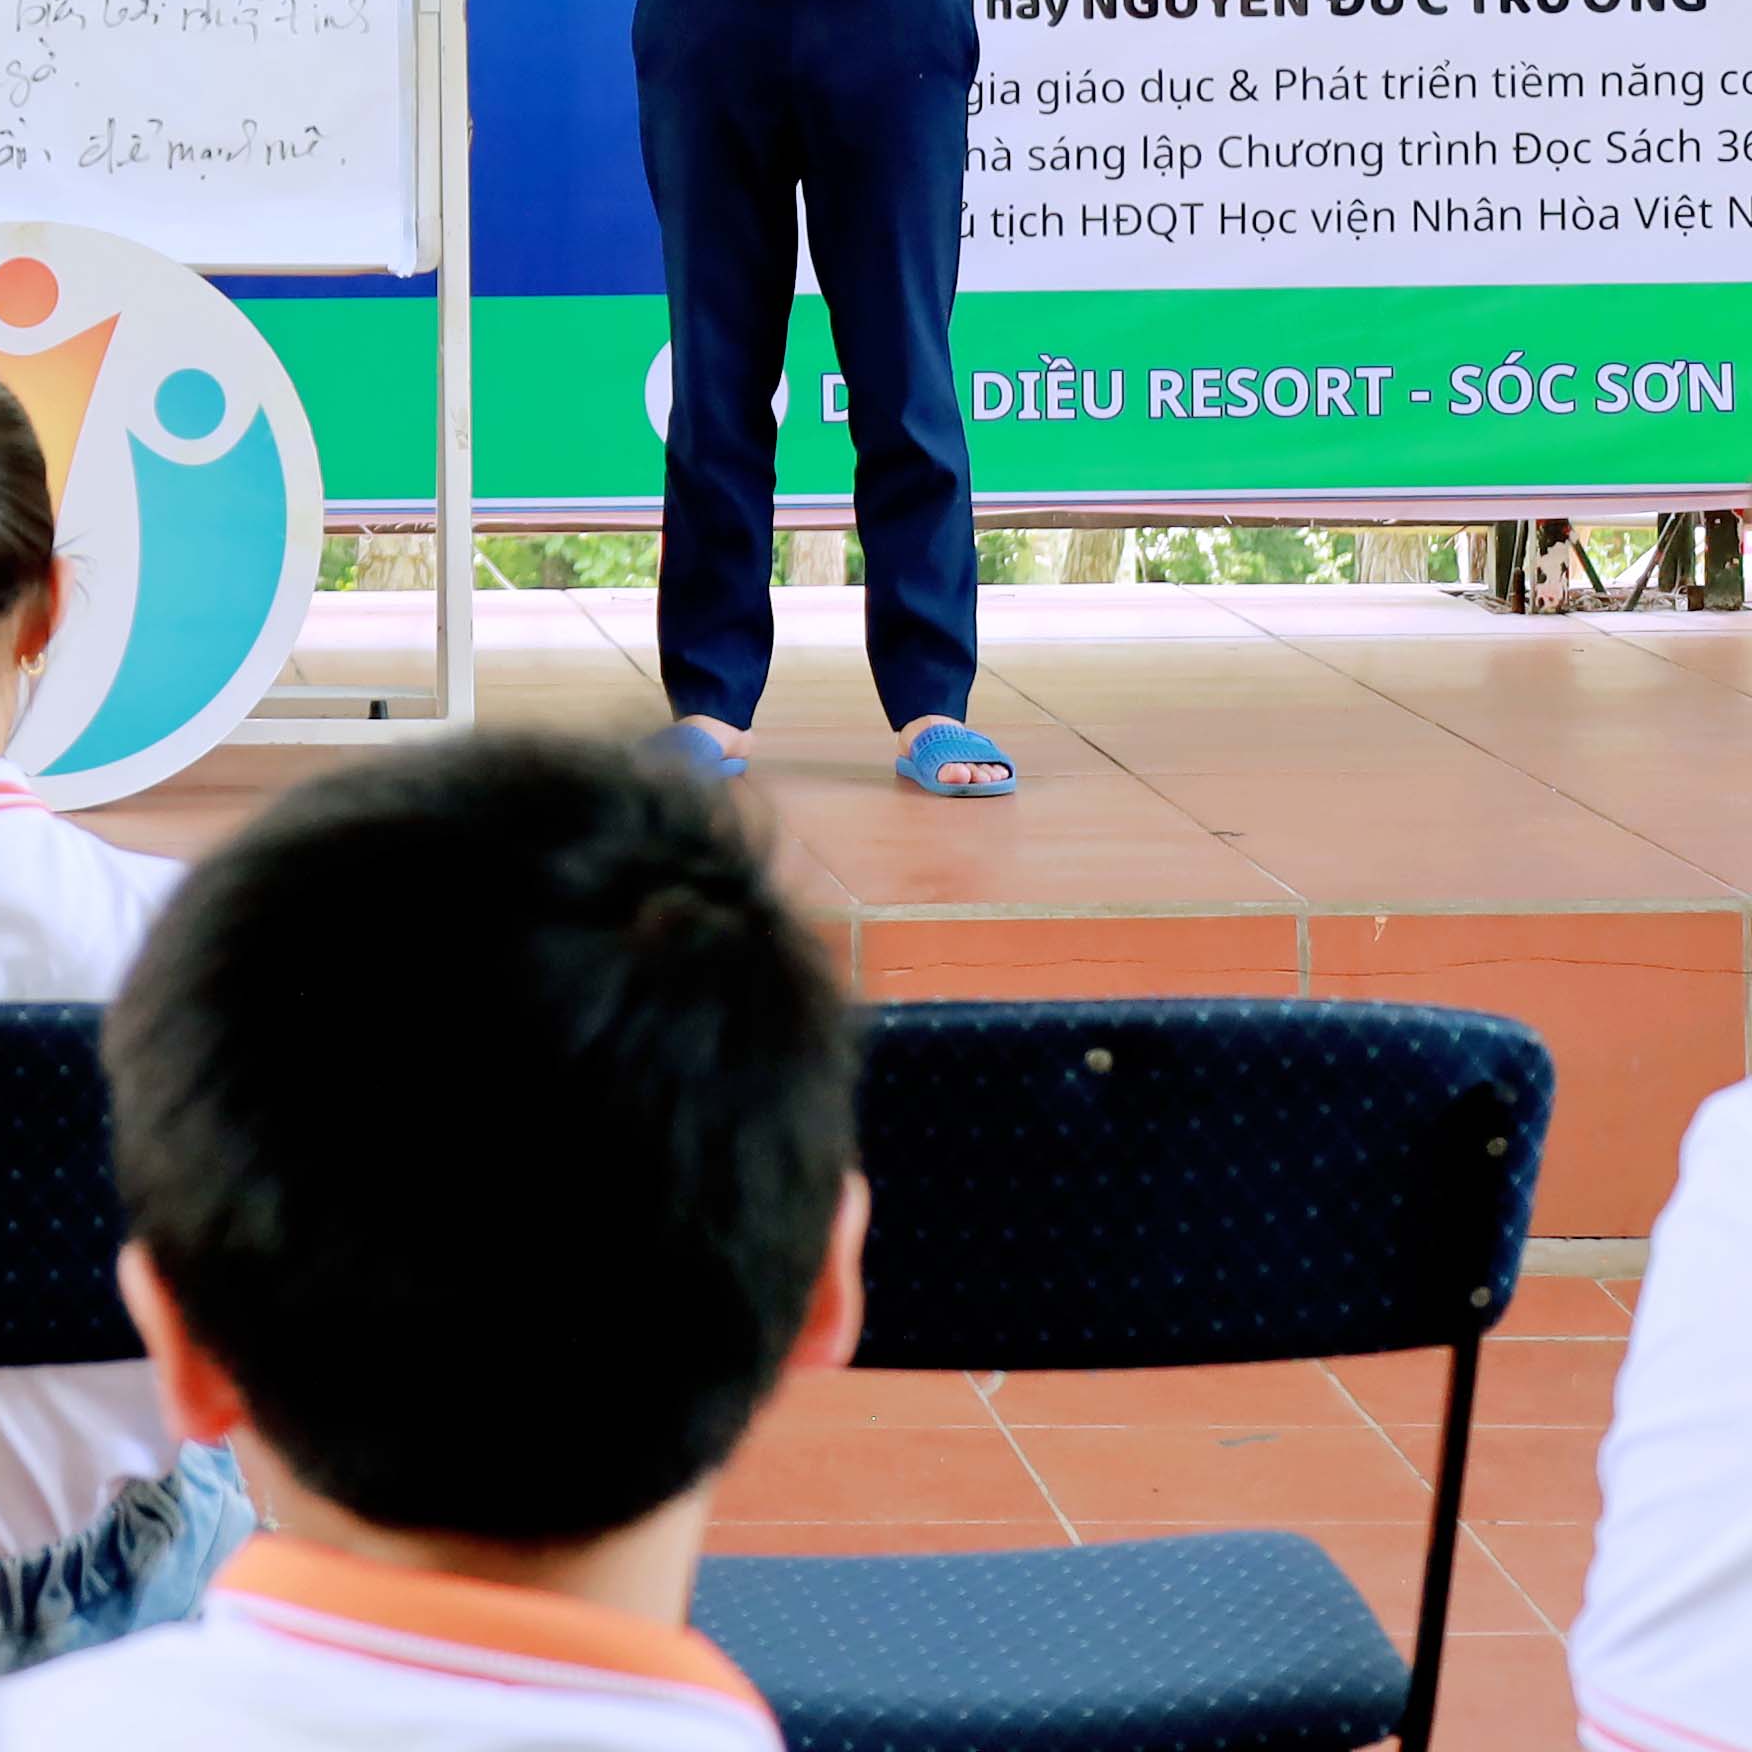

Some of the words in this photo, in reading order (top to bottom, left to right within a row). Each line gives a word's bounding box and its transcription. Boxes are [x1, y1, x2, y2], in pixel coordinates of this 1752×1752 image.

[967, 72, 1021, 116] gia
[1036, 69, 1126, 114] giáo
[1140, 66, 1215, 109] dục
[1228, 71, 1259, 104] &
[1274, 64, 1368, 103] Phát
[1382, 58, 1478, 101] triển
[1493, 58, 1587, 99] tiềm
[1601, 62, 1704, 106] năng
[1028, 135, 1126, 180] sáng
[1142, 133, 1202, 177] lập
[1218, 132, 1384, 176] Chương
[1398, 130, 1497, 166] trình
[1512, 130, 1587, 171] Đọc
[1606, 127, 1701, 163] Sách
[990, 202, 1065, 245] tịch
[1081, 203, 1204, 242] HĐQT
[1219, 202, 1297, 244] Học
[1311, 199, 1396, 242] viện
[1412, 197, 1523, 233] Nhân
[1540, 195, 1619, 231] Hòa
[1634, 194, 1713, 237] Việt
[972, 352, 1125, 421] DIỀU
[1148, 364, 1393, 421] RESORT
[1449, 352, 1575, 416] SÓC
[1594, 359, 1736, 415] SƠN
